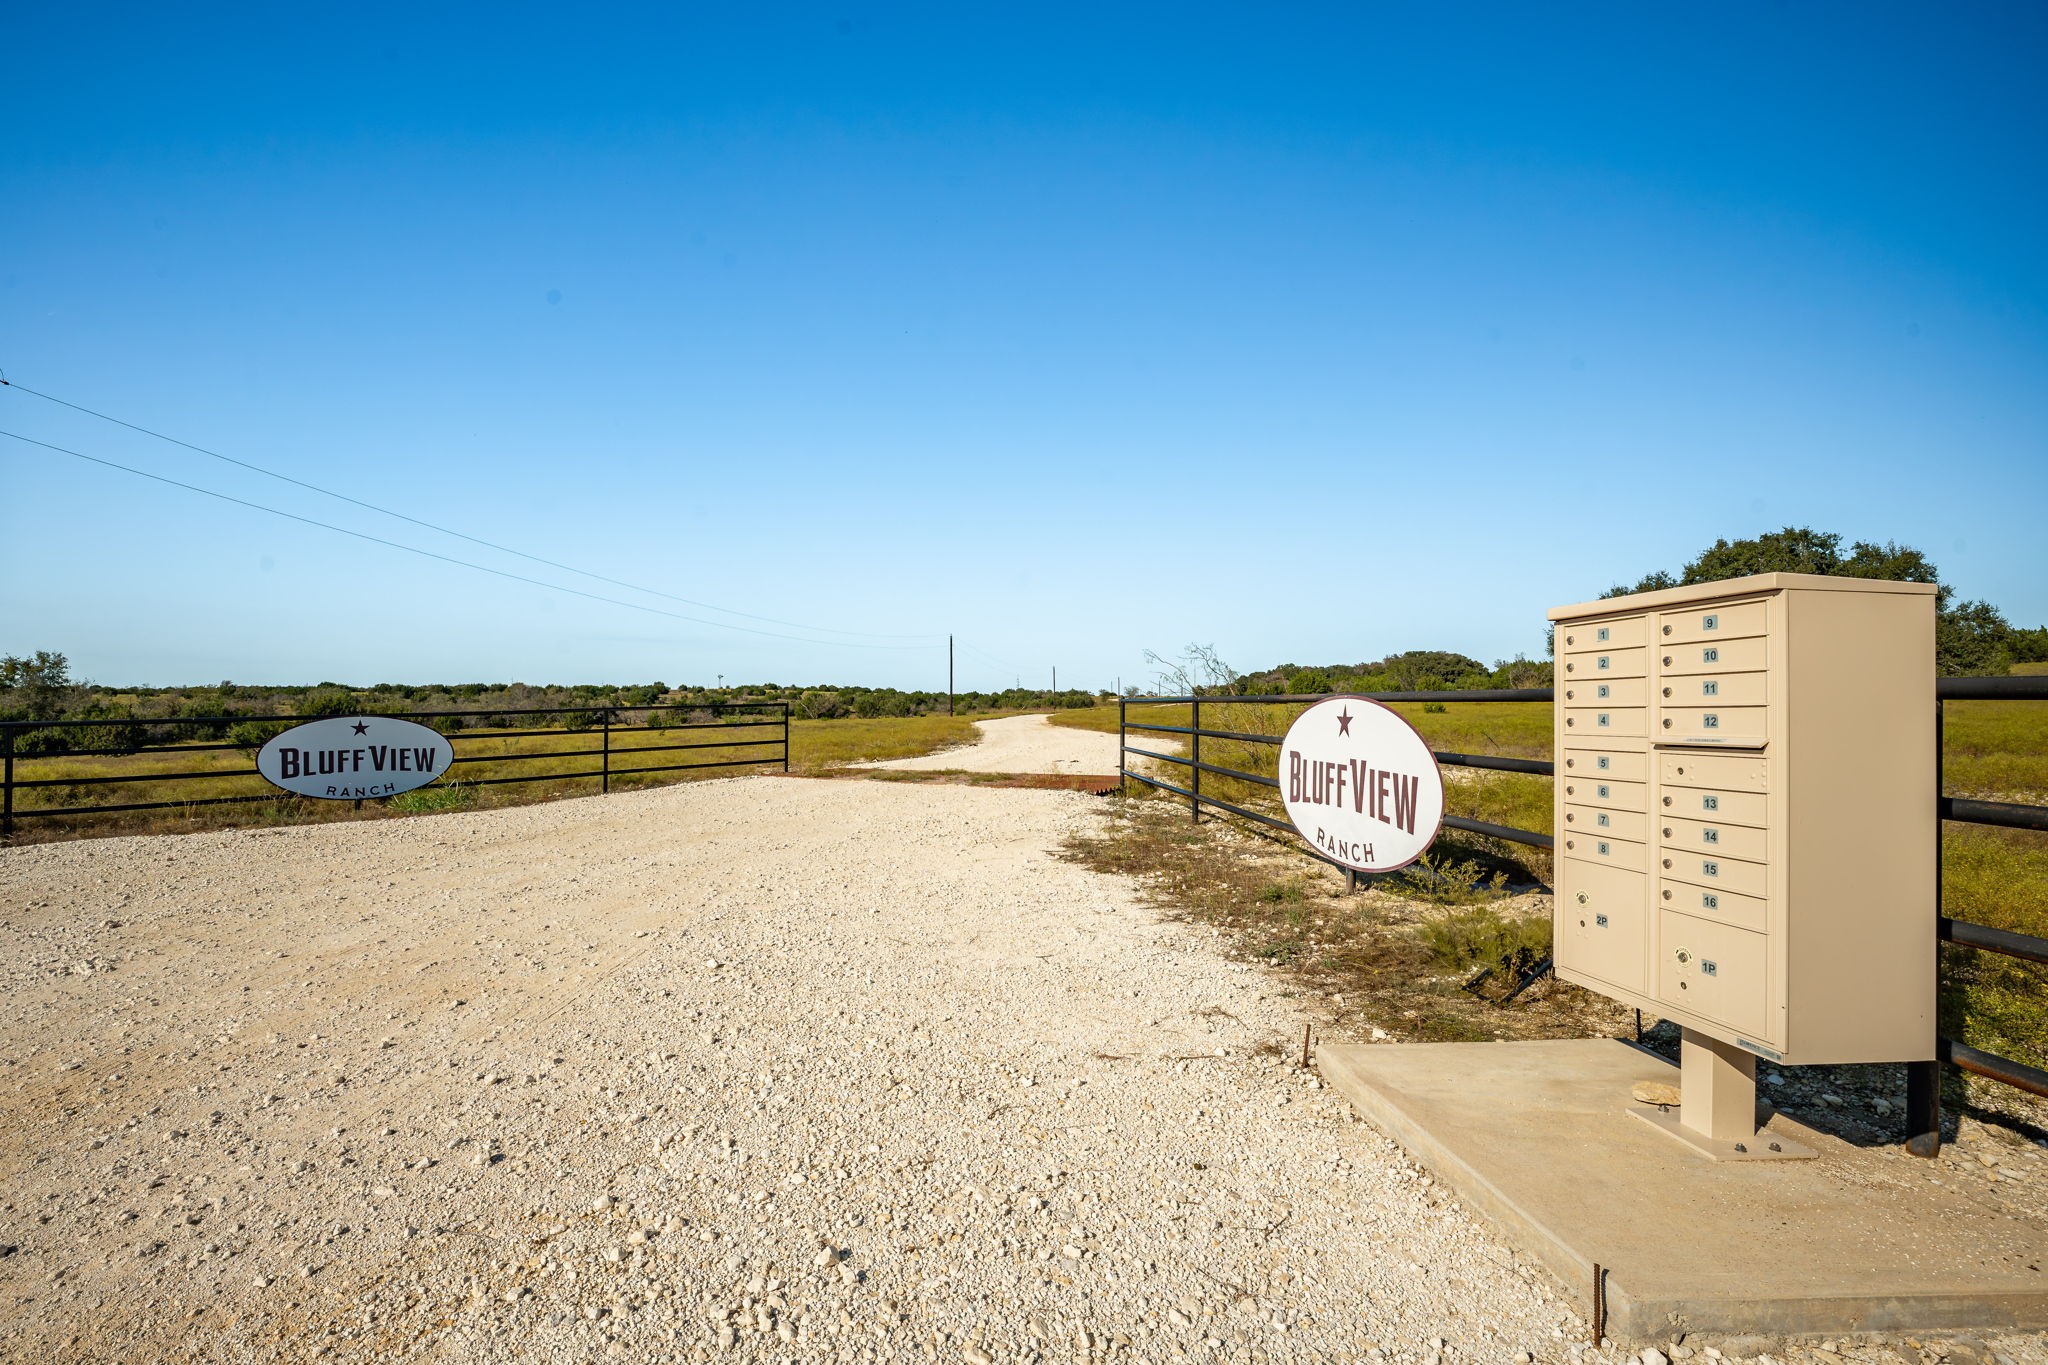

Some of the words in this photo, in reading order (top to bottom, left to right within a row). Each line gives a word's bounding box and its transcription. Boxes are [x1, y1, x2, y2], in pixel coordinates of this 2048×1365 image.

[1704, 650, 1717, 661] 10
[1704, 683, 1716, 694] 11
[1704, 716, 1717, 727] 12
[326, 783, 395, 797] RANCH
[1704, 798, 1717, 809] 13
[1704, 831, 1717, 842] 14
[1317, 827, 1375, 861] RANCH
[1704, 863, 1717, 875] 15
[1704, 896, 1717, 908] 16
[1596, 915, 1608, 926] 2P
[1702, 962, 1716, 973] 1P
